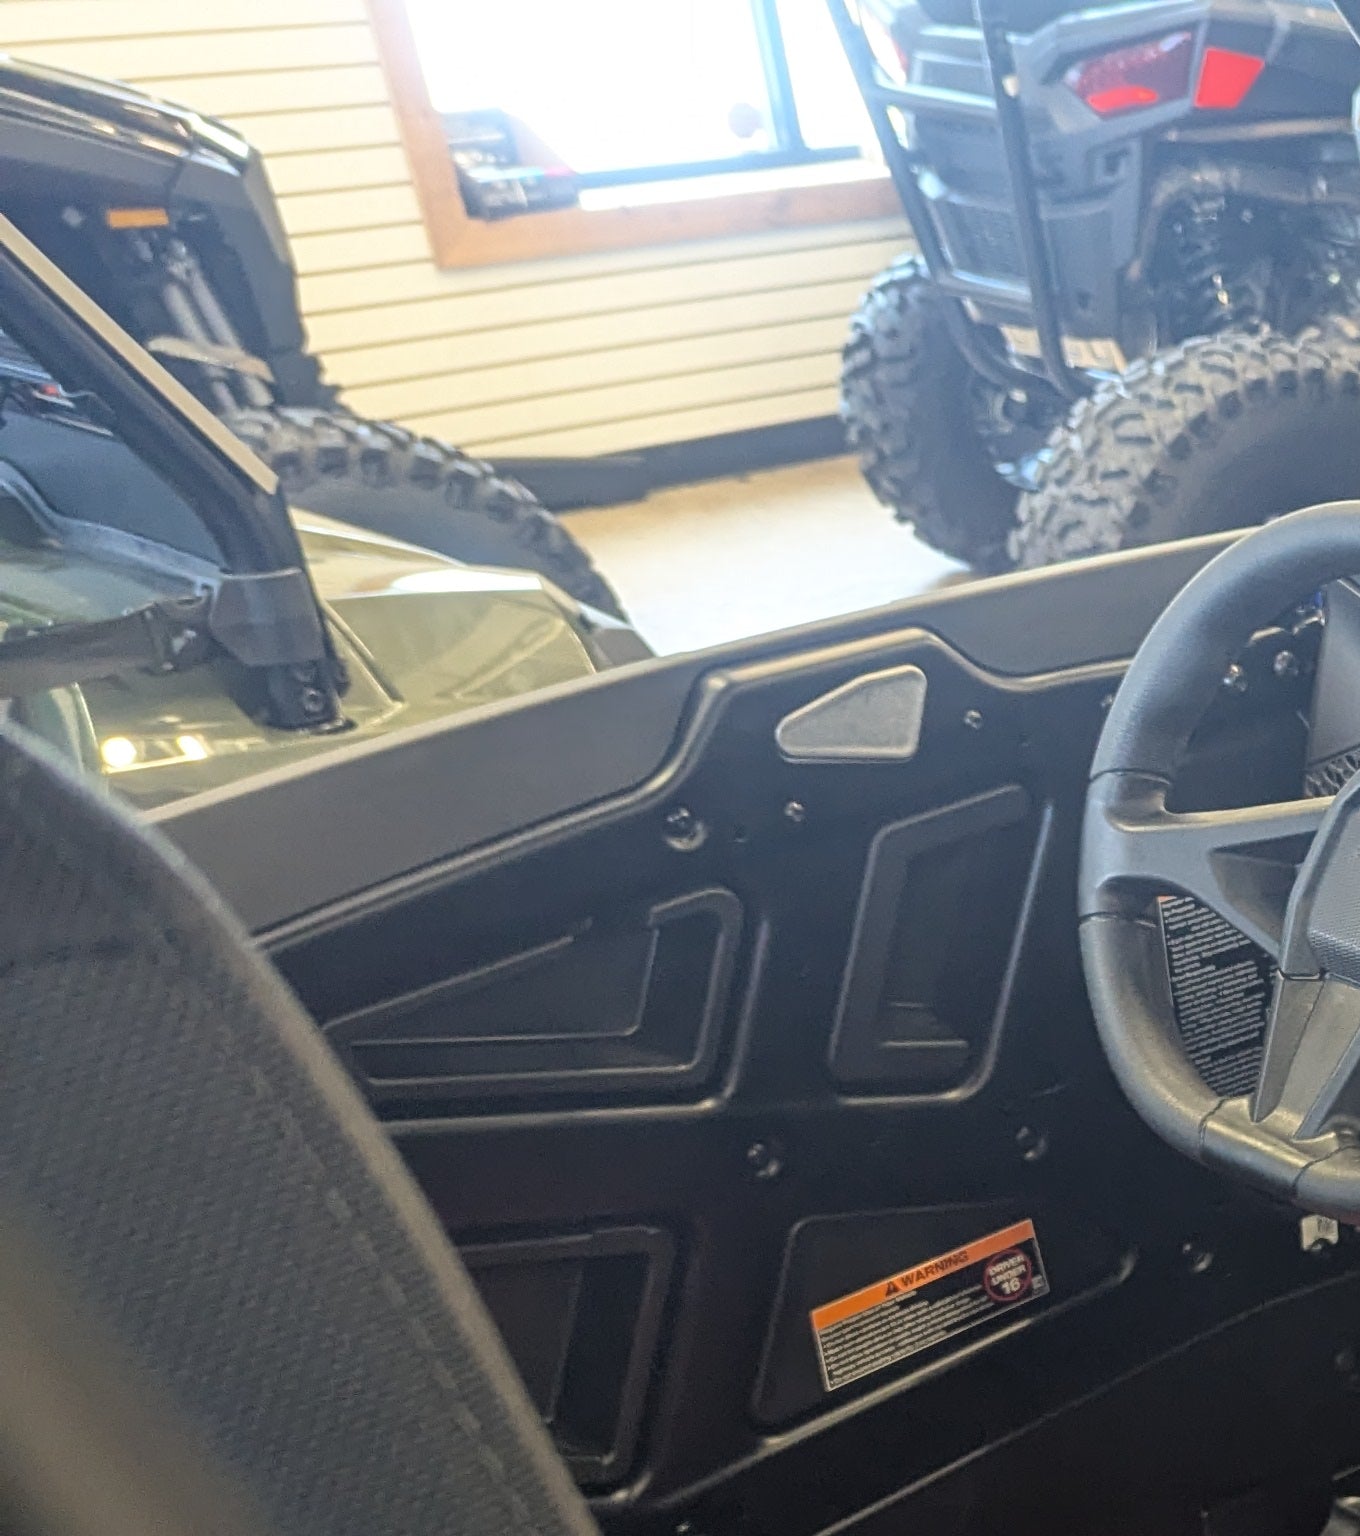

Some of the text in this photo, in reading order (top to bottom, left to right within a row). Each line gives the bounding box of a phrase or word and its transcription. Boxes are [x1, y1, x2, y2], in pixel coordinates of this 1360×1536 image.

[900, 1250, 969, 1287] WARNING
[988, 1255, 1025, 1276] DRIVER
[991, 1264, 1027, 1286] UNDER
[1001, 1277, 1022, 1296] 16
